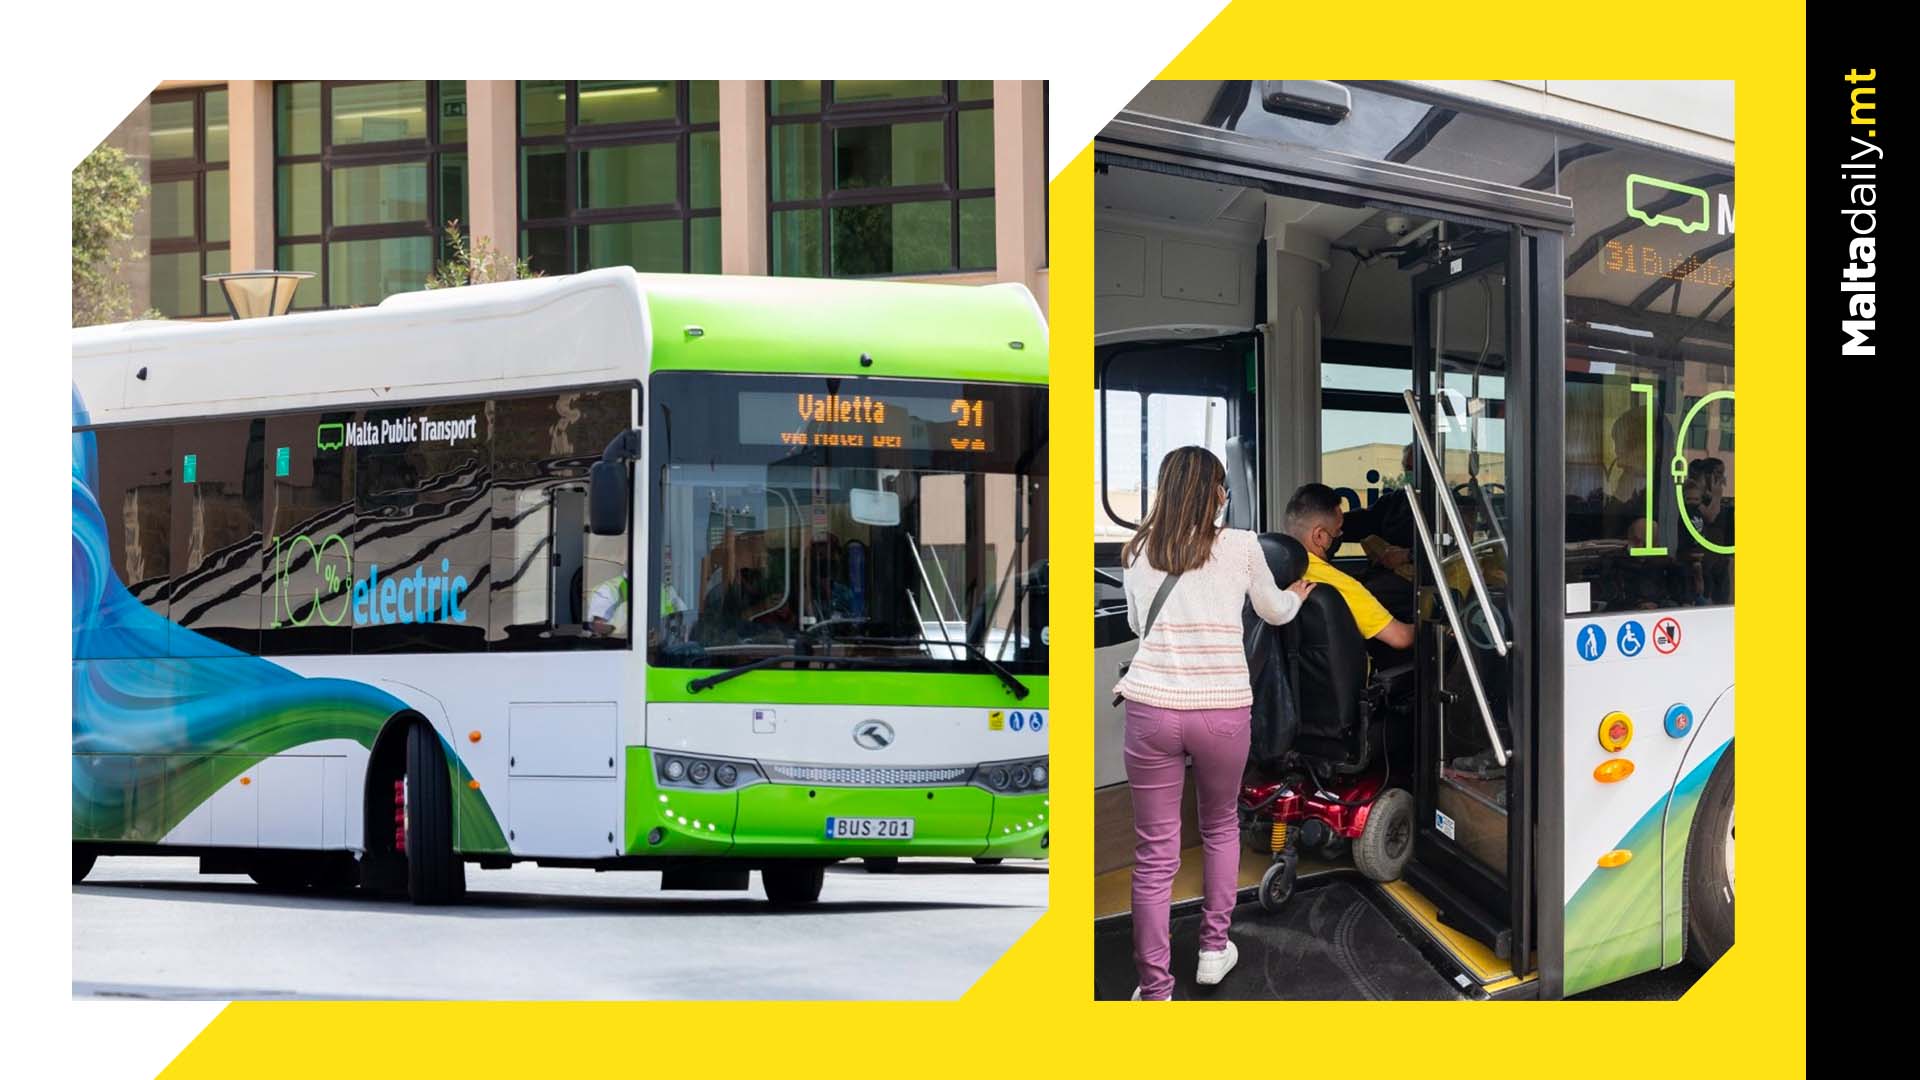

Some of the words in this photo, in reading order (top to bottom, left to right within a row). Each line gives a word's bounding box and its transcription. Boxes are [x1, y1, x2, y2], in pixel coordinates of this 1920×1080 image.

[1606, 239, 1637, 273] 31
[797, 393, 885, 424] Valletta
[345, 422, 379, 447] Malta
[381, 416, 418, 444] Public
[419, 414, 477, 447] Transport
[353, 558, 469, 625] electric
[838, 820, 871, 836] BUS
[878, 820, 909, 837] 201
